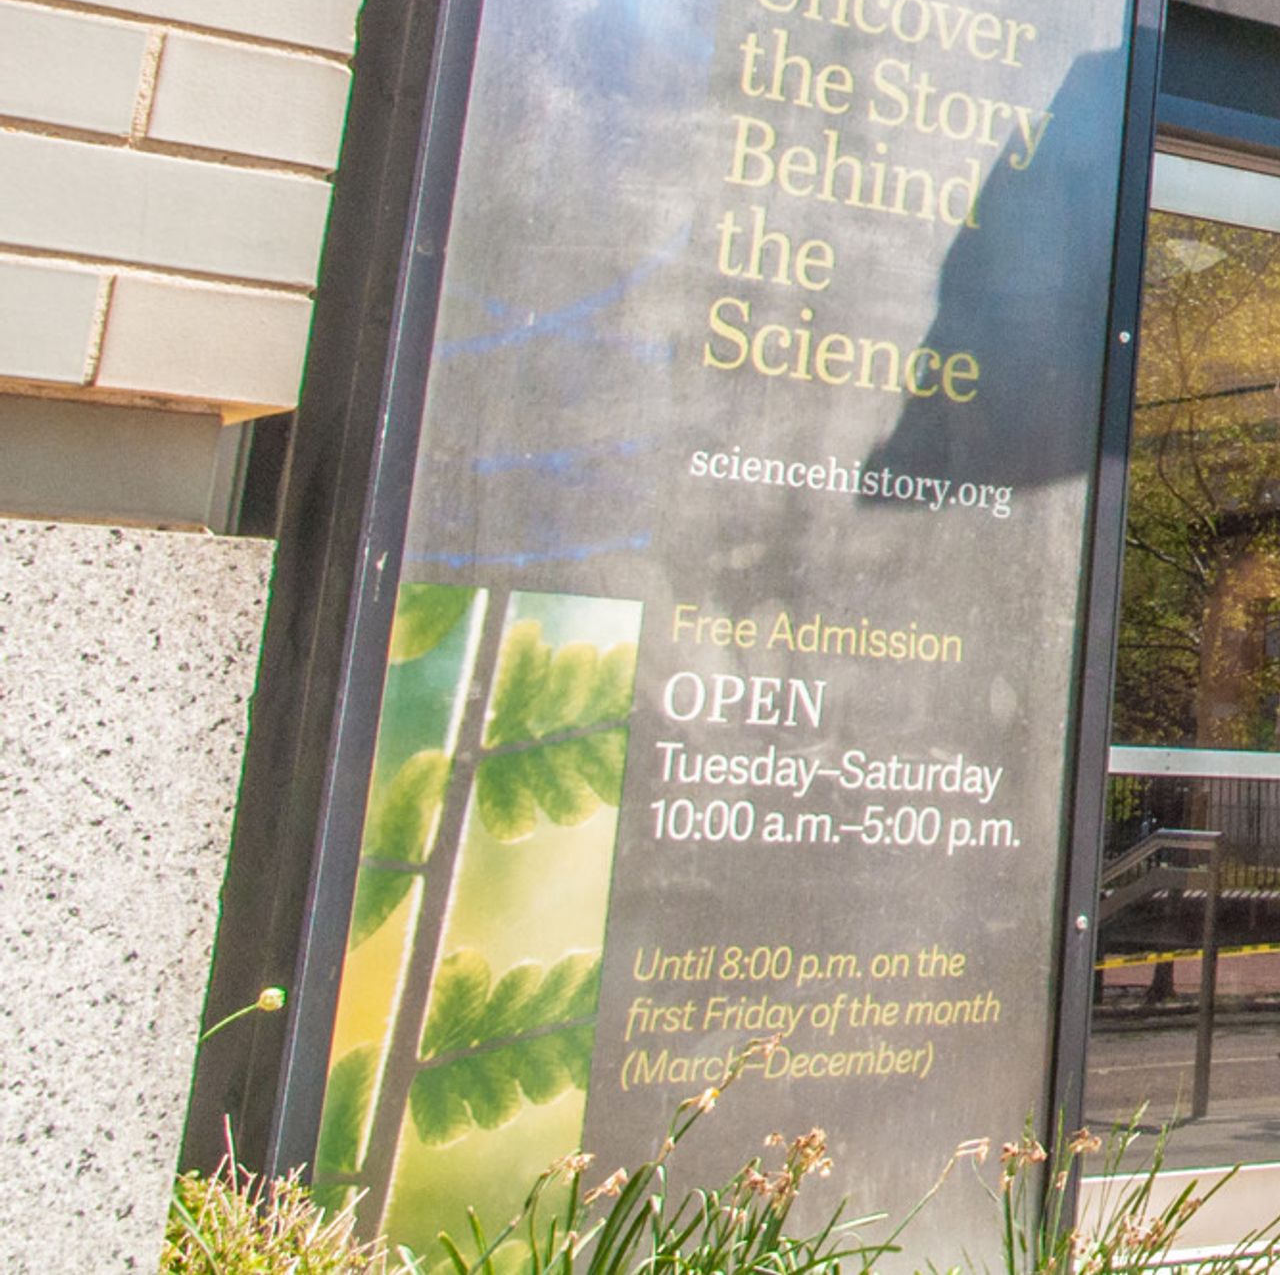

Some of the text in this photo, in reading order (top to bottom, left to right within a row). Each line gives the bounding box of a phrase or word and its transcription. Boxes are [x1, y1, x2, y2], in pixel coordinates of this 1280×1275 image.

[739, 28, 1055, 171] the Story
[722, 114, 984, 229] Behind
[715, 205, 836, 293] the
[702, 295, 982, 404] Science
[688, 445, 1015, 520] sciencehistory.org
[671, 603, 964, 663] Free Admission
[661, 670, 828, 729] OPEN
[650, 799, 756, 844] 10:00
[946, 813, 1022, 856] p.m.
[632, 944, 967, 987] Until 8:00 p.m. on the
[624, 989, 1002, 1042] first Friday of the month
